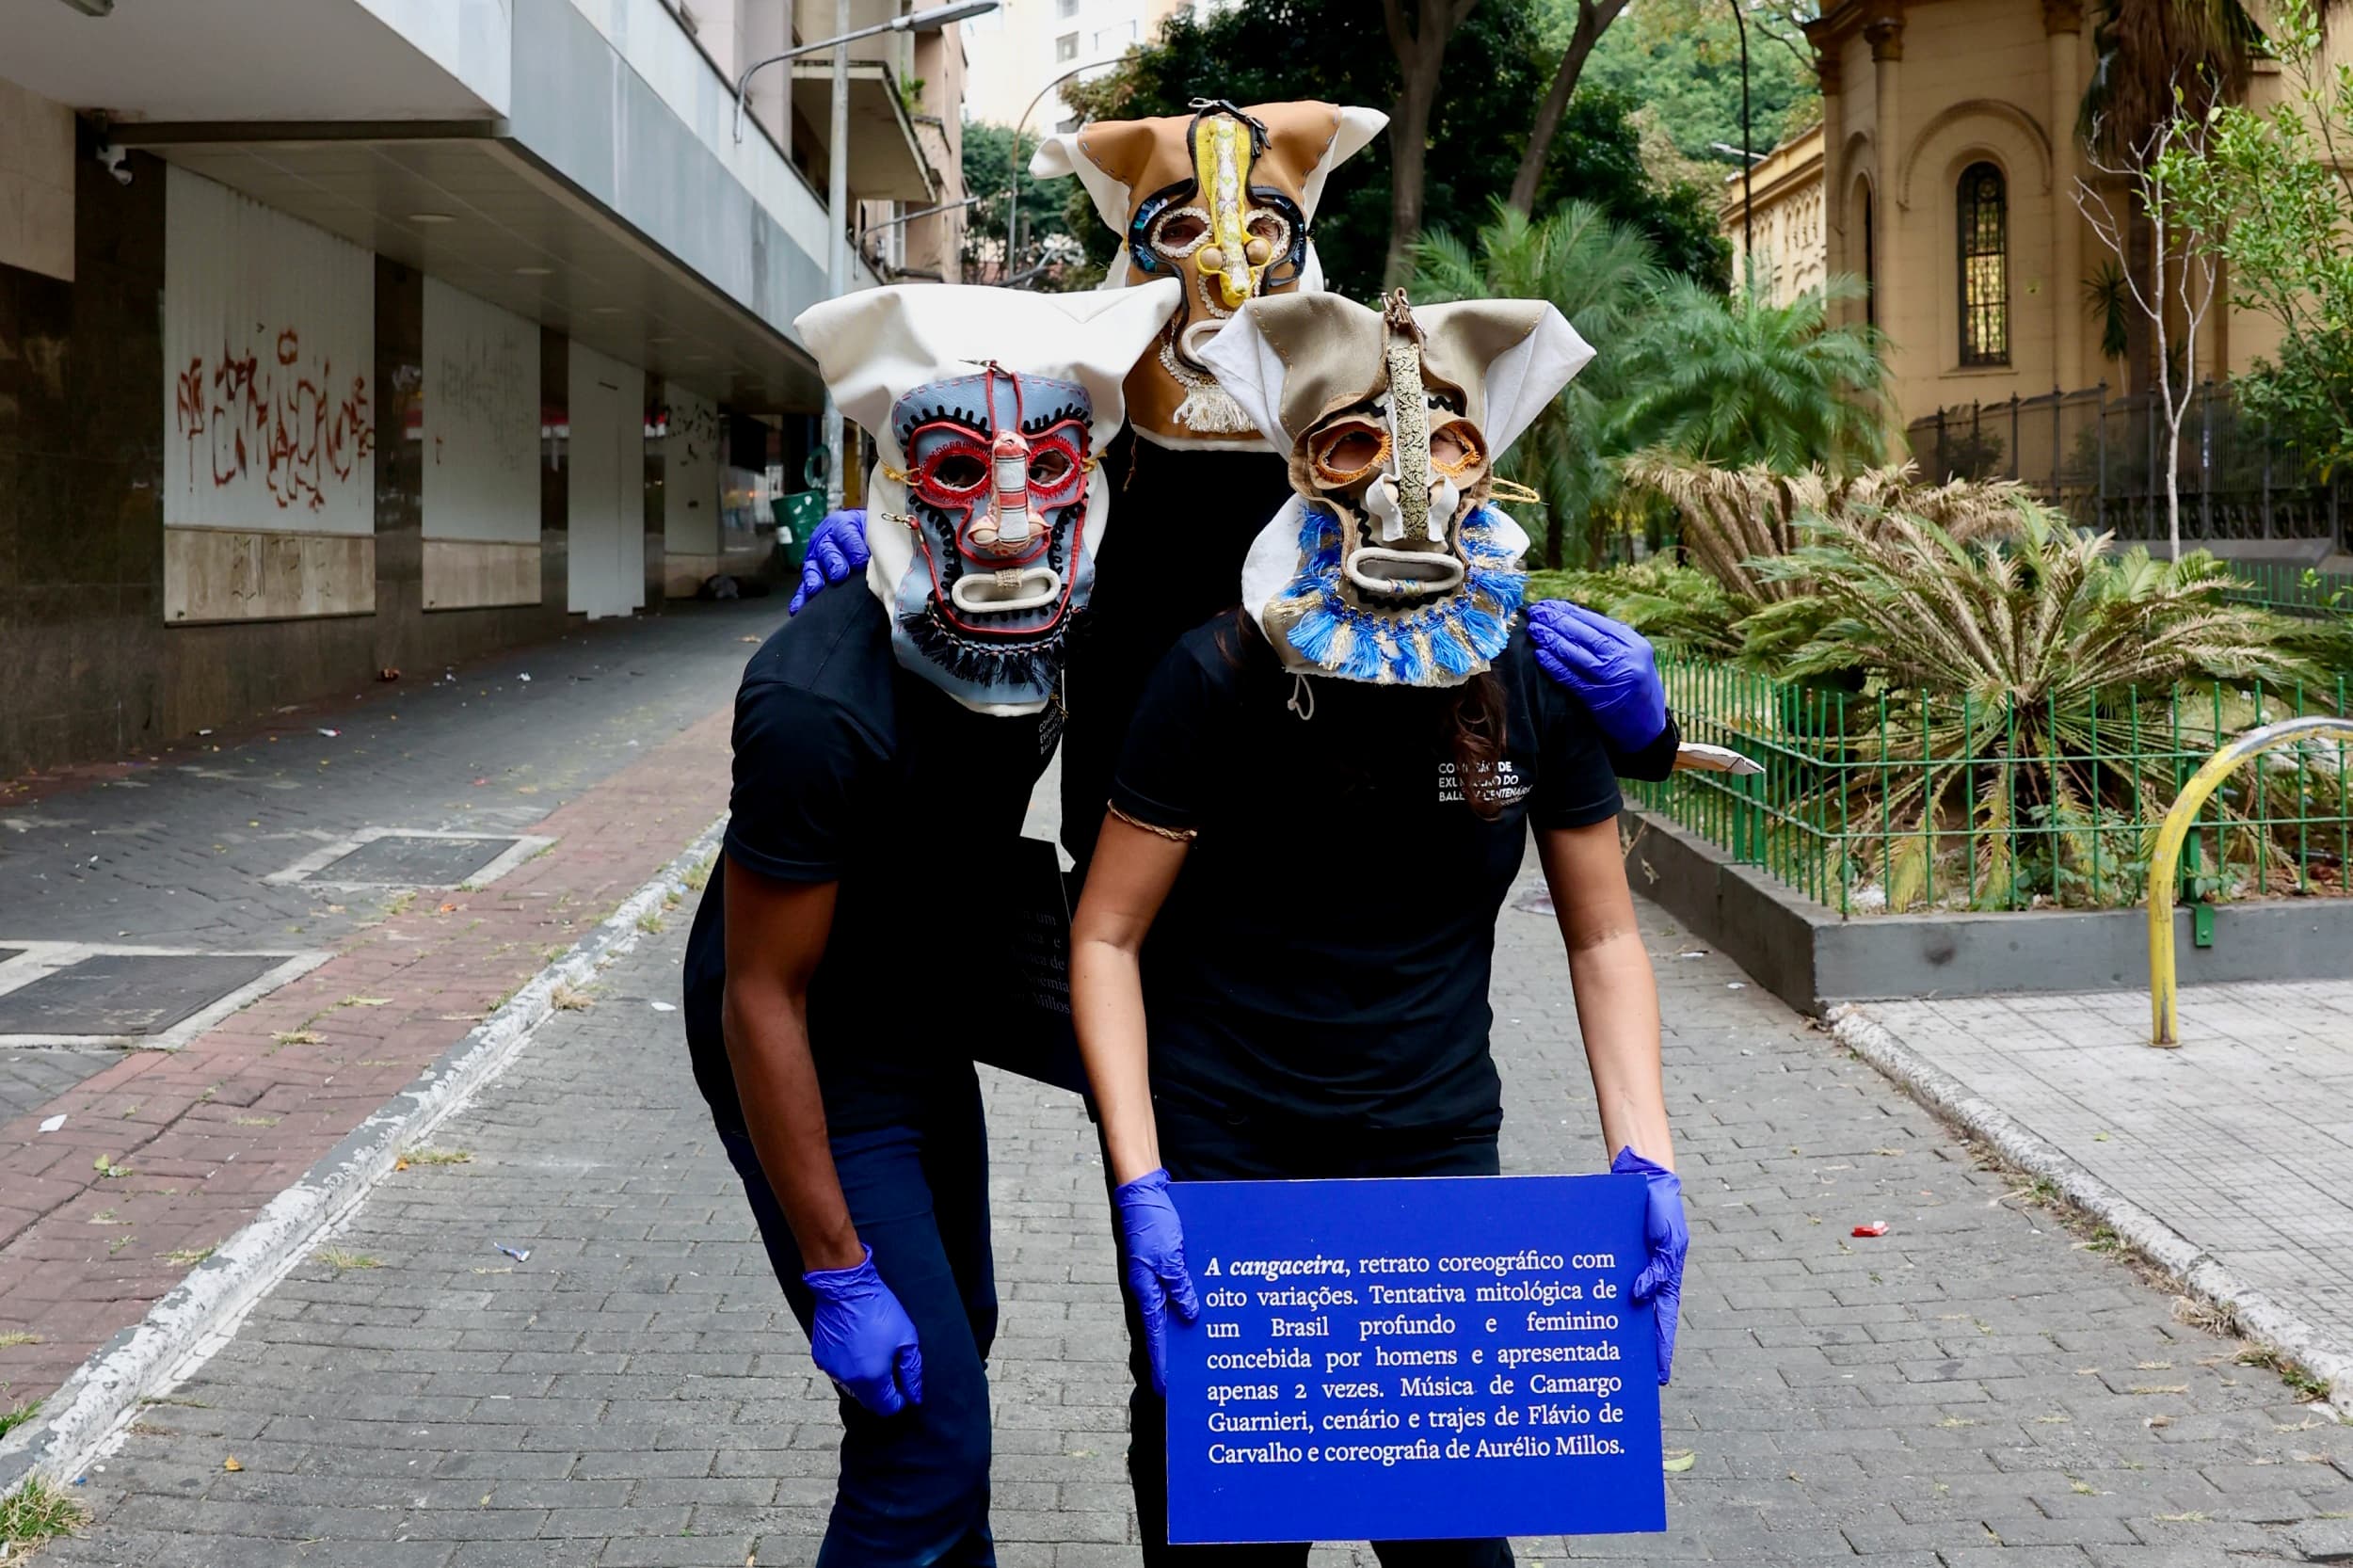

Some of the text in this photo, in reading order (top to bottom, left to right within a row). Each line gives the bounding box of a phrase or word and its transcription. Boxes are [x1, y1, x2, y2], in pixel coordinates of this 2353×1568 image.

[1497, 760, 1513, 773] DE
[1502, 775, 1519, 786] DO
[1204, 1249, 1616, 1282] A cangaceira, retrato coreográfico com
[1205, 1278, 1618, 1312] oito variações. Tentativa mitológica de
[1206, 1310, 1619, 1342] um Brasil profundo e feminino
[1207, 1339, 1622, 1374] concebida por homens e apresentada
[1207, 1373, 1623, 1407] apenas 2 vezes. Música de Camargo
[1208, 1401, 1624, 1434] Guarnieri, cenário e trajes de Flávio de
[1208, 1433, 1625, 1467] Carvalho e coreografia de Aurélio Millos.
